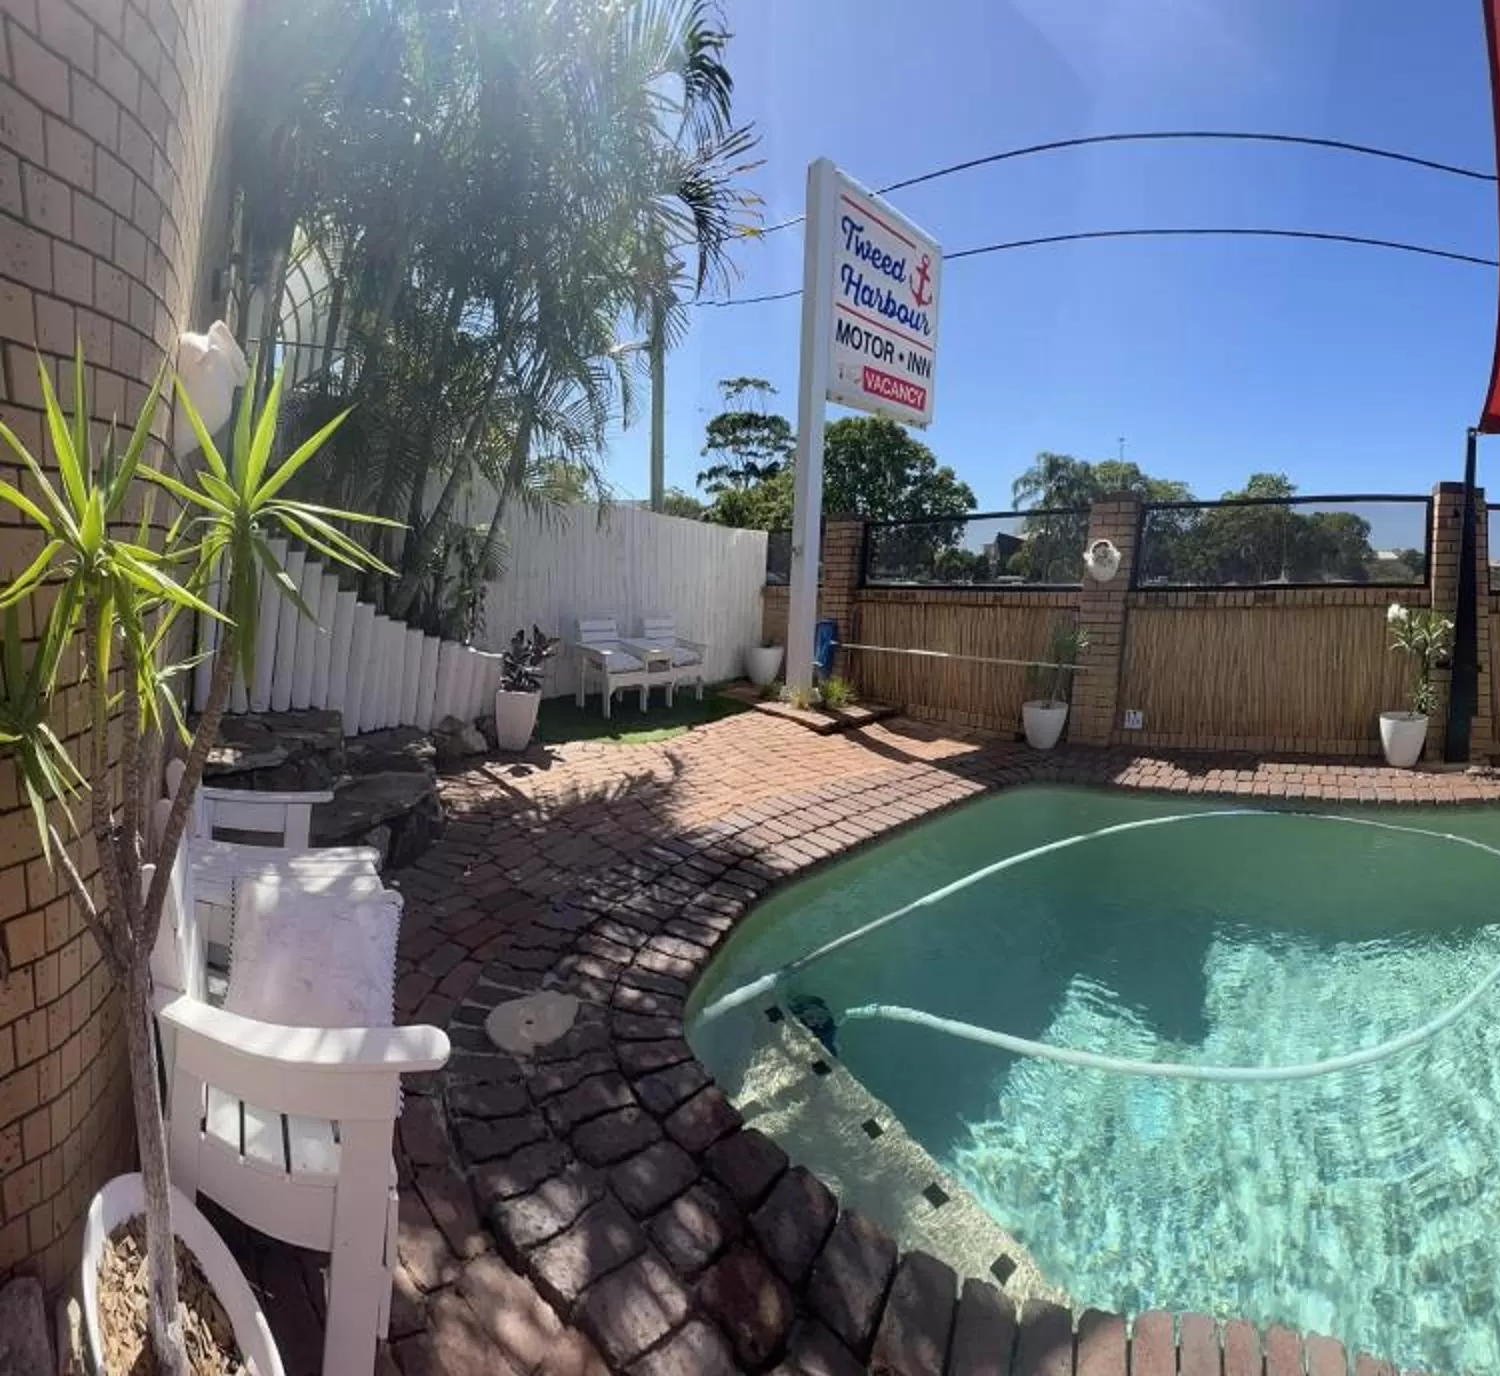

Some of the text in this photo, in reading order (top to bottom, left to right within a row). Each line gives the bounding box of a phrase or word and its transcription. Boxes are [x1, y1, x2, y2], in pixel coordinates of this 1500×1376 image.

[841, 215, 906, 283] Tweed
[840, 264, 930, 336] Harbour
[836, 319, 931, 378] MOTOR INN
[864, 370, 924, 407] VACANCY
